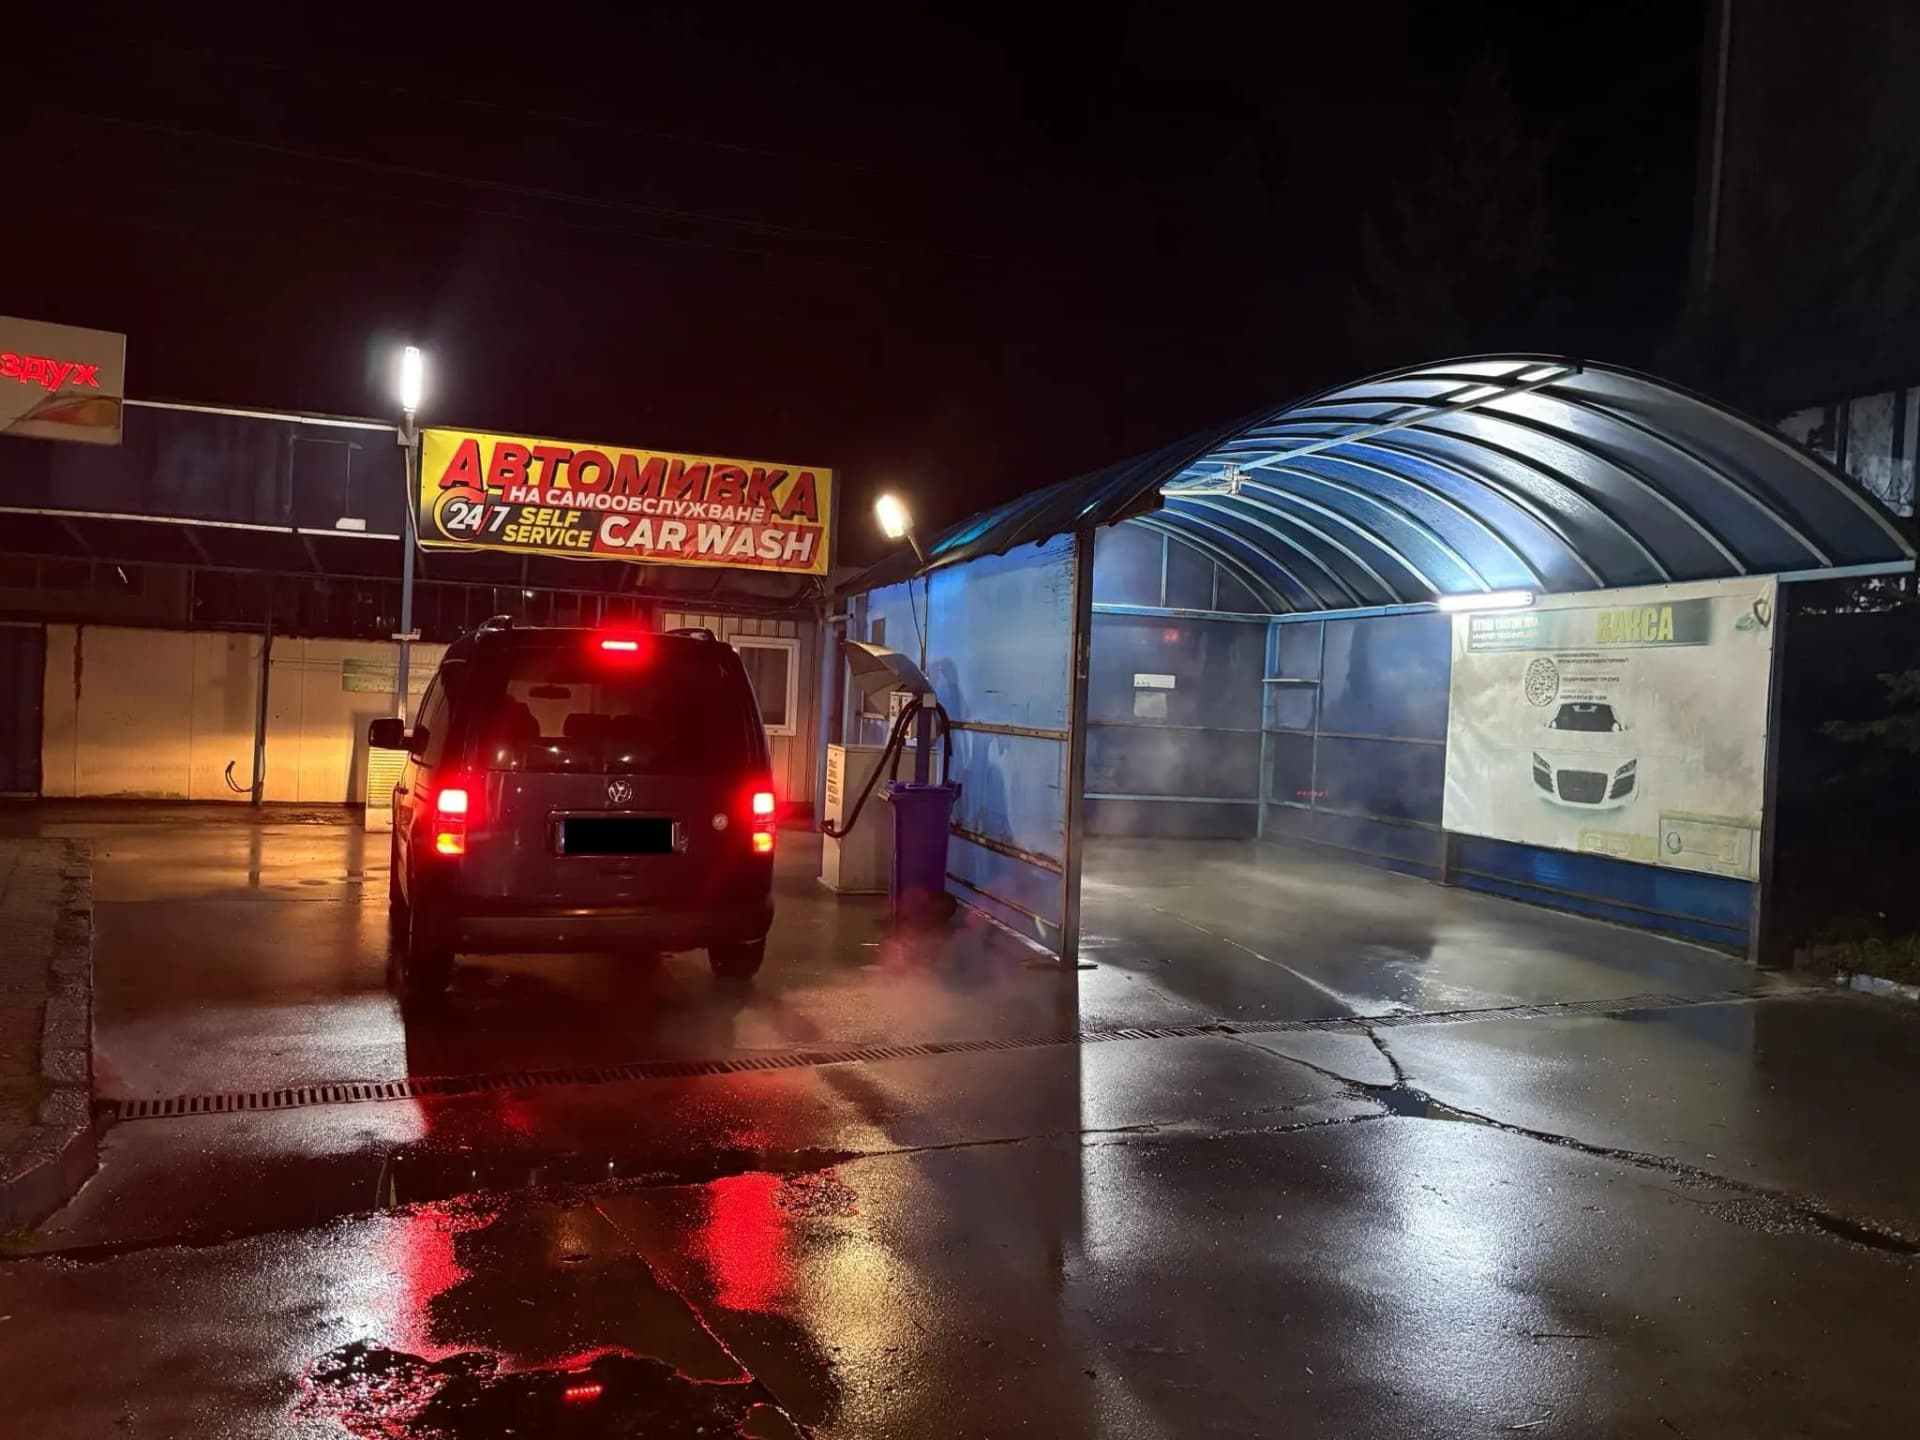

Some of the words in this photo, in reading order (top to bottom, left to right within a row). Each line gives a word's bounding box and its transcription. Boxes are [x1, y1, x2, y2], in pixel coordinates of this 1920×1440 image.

[438, 438, 819, 523] АВТОМИВКА
[446, 502, 511, 535] 24/7
[508, 485, 541, 504] НА
[545, 488, 766, 523] САМООБСЛУЖВАНЕ
[517, 506, 582, 527] SELF
[502, 524, 593, 548] SERVICE
[600, 515, 688, 551] CAR
[697, 522, 814, 562] WASH
